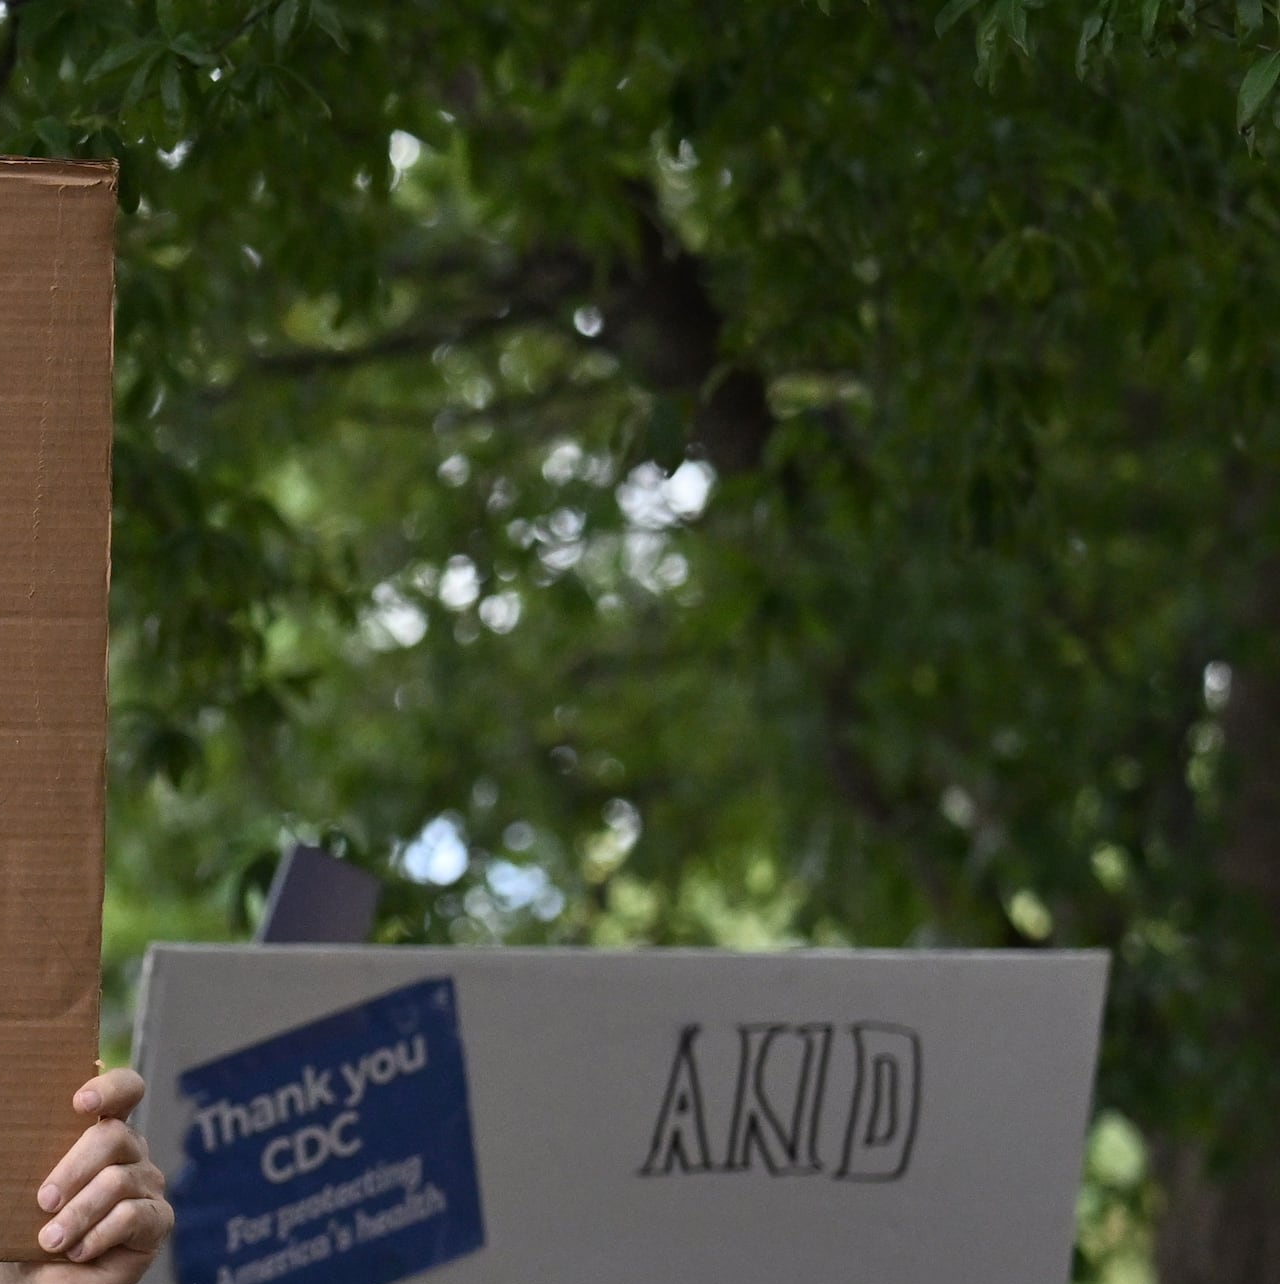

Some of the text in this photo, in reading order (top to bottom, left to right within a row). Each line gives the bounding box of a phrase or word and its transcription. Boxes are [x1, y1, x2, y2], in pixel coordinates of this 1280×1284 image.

[195, 1034, 428, 1151] Thank you
[636, 1020, 924, 1183] AND
[260, 1110, 364, 1185] CDC
[225, 1153, 424, 1254] For protecting
[354, 1182, 448, 1244] health
